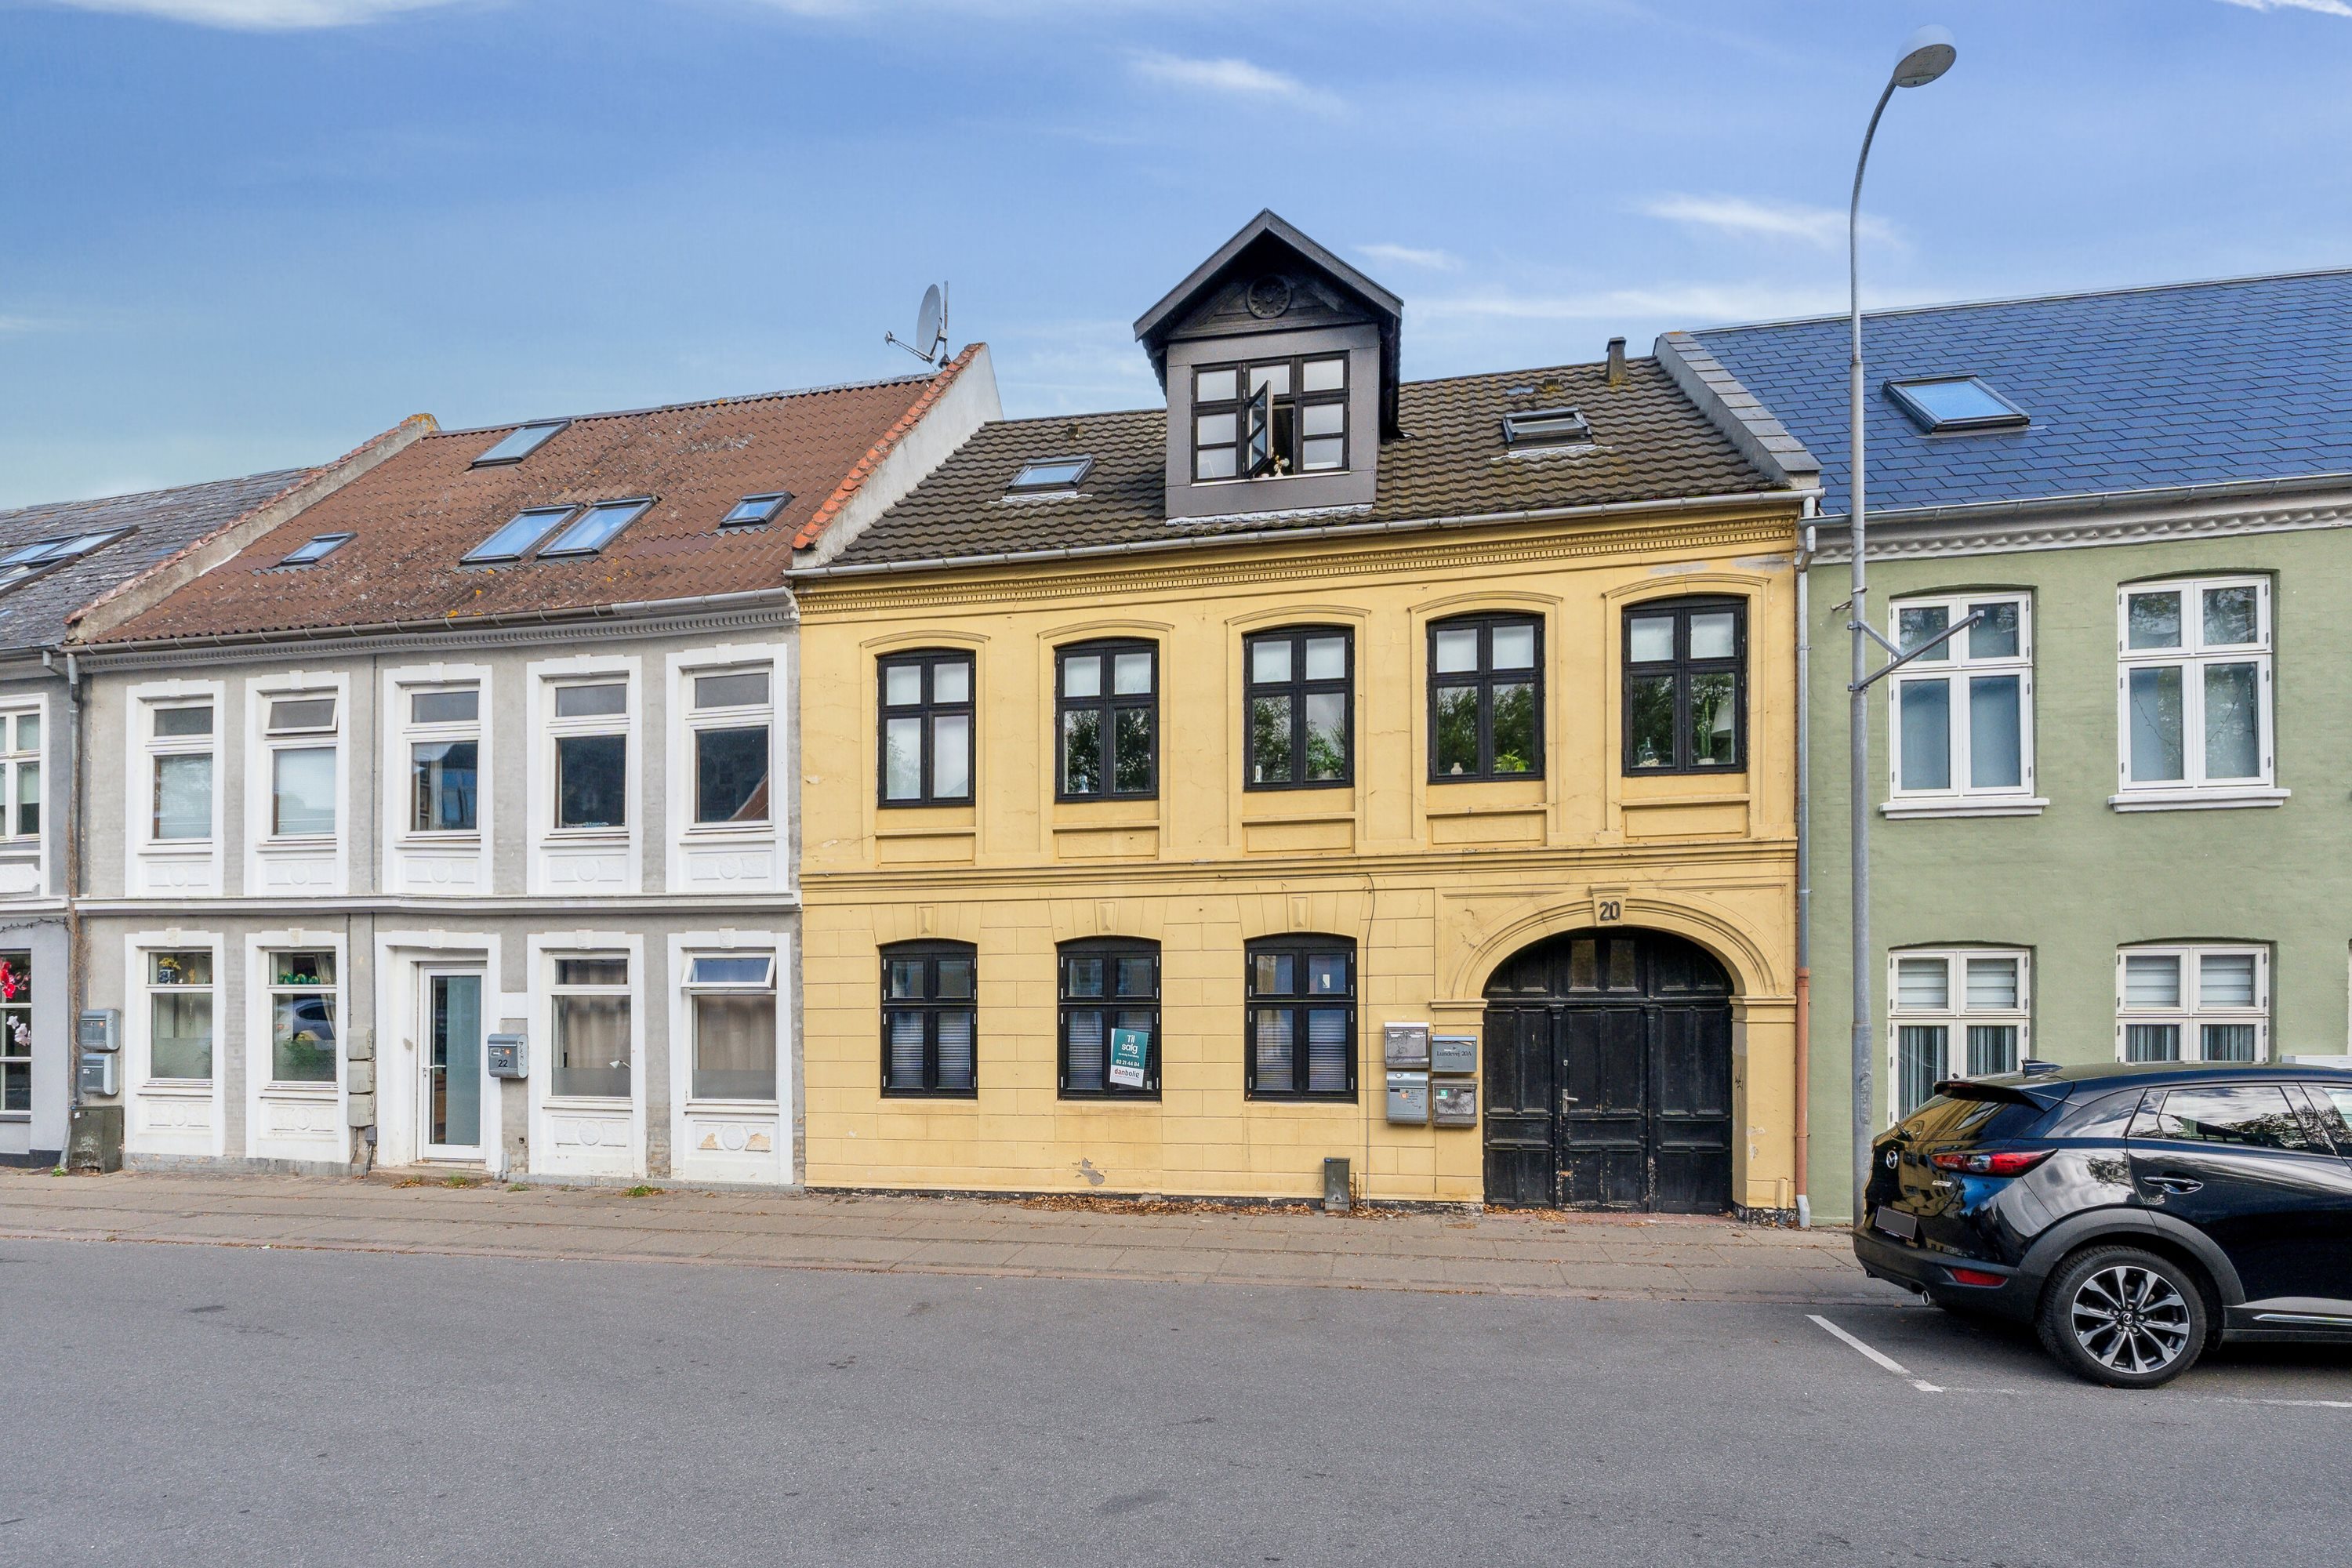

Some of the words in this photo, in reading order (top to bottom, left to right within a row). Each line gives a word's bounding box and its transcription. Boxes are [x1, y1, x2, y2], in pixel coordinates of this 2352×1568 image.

[1599, 901, 1620, 921] 20
[1122, 1044, 1138, 1054] salg
[1115, 1069, 1139, 1078] danbolig
